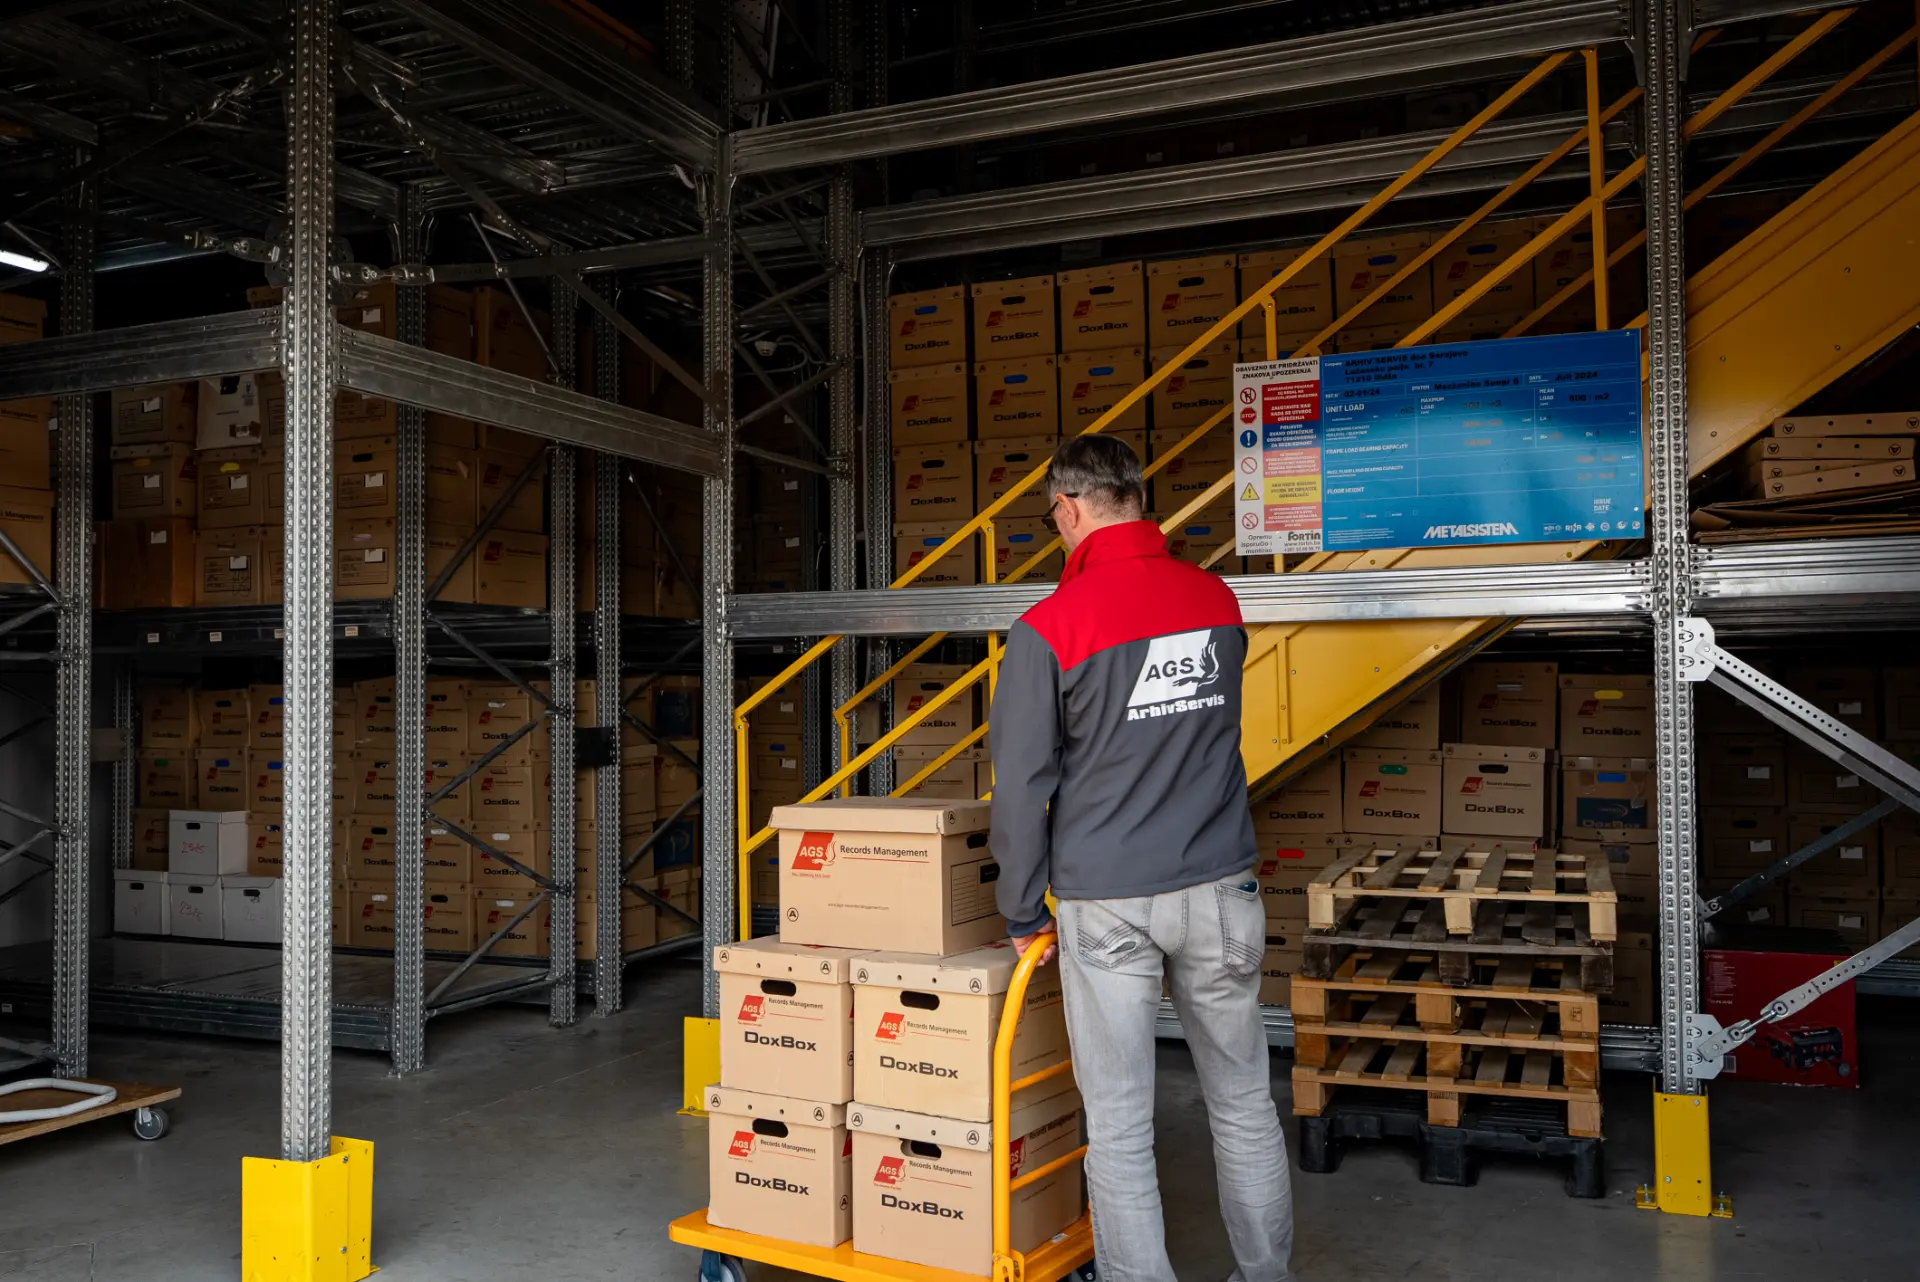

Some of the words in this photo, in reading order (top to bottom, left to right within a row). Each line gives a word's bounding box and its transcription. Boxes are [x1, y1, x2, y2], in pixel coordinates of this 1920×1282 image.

[1235, 364, 1268, 373] OBAVEZNO
[1242, 371, 1271, 379] ZNAKOVA
[1574, 371, 1598, 379] 2024
[1325, 405, 1342, 413] UNIT
[1344, 403, 1365, 412] LOAD
[1423, 522, 1519, 539] METALSISTEM
[1144, 657, 1195, 682] AGS
[1127, 694, 1225, 721] ArhivServis
[1269, 811, 1325, 820] DoxBox
[1363, 808, 1420, 819] DoxBox
[1465, 803, 1525, 815] DoxBox
[799, 846, 824, 858] AGS
[840, 844, 871, 855] Records
[873, 846, 928, 858] Management
[743, 1004, 758, 1013] AGS
[768, 997, 789, 1006] Records
[789, 1000, 823, 1010] Management
[880, 1021, 897, 1031] AGS
[906, 1020, 928, 1031] Records
[928, 1024, 968, 1036] Management
[744, 1031, 817, 1051] DoxBox
[880, 1055, 959, 1079] DoxBox
[733, 1140, 749, 1149] AGS
[760, 1139, 781, 1148] Records
[781, 1142, 816, 1154] Management
[1010, 1150, 1019, 1164] GS
[880, 1165, 897, 1175] AGS
[909, 1160, 932, 1170] Records
[933, 1164, 973, 1177] Management
[735, 1171, 810, 1195] DoxBox
[881, 1194, 964, 1220] DoxBox
